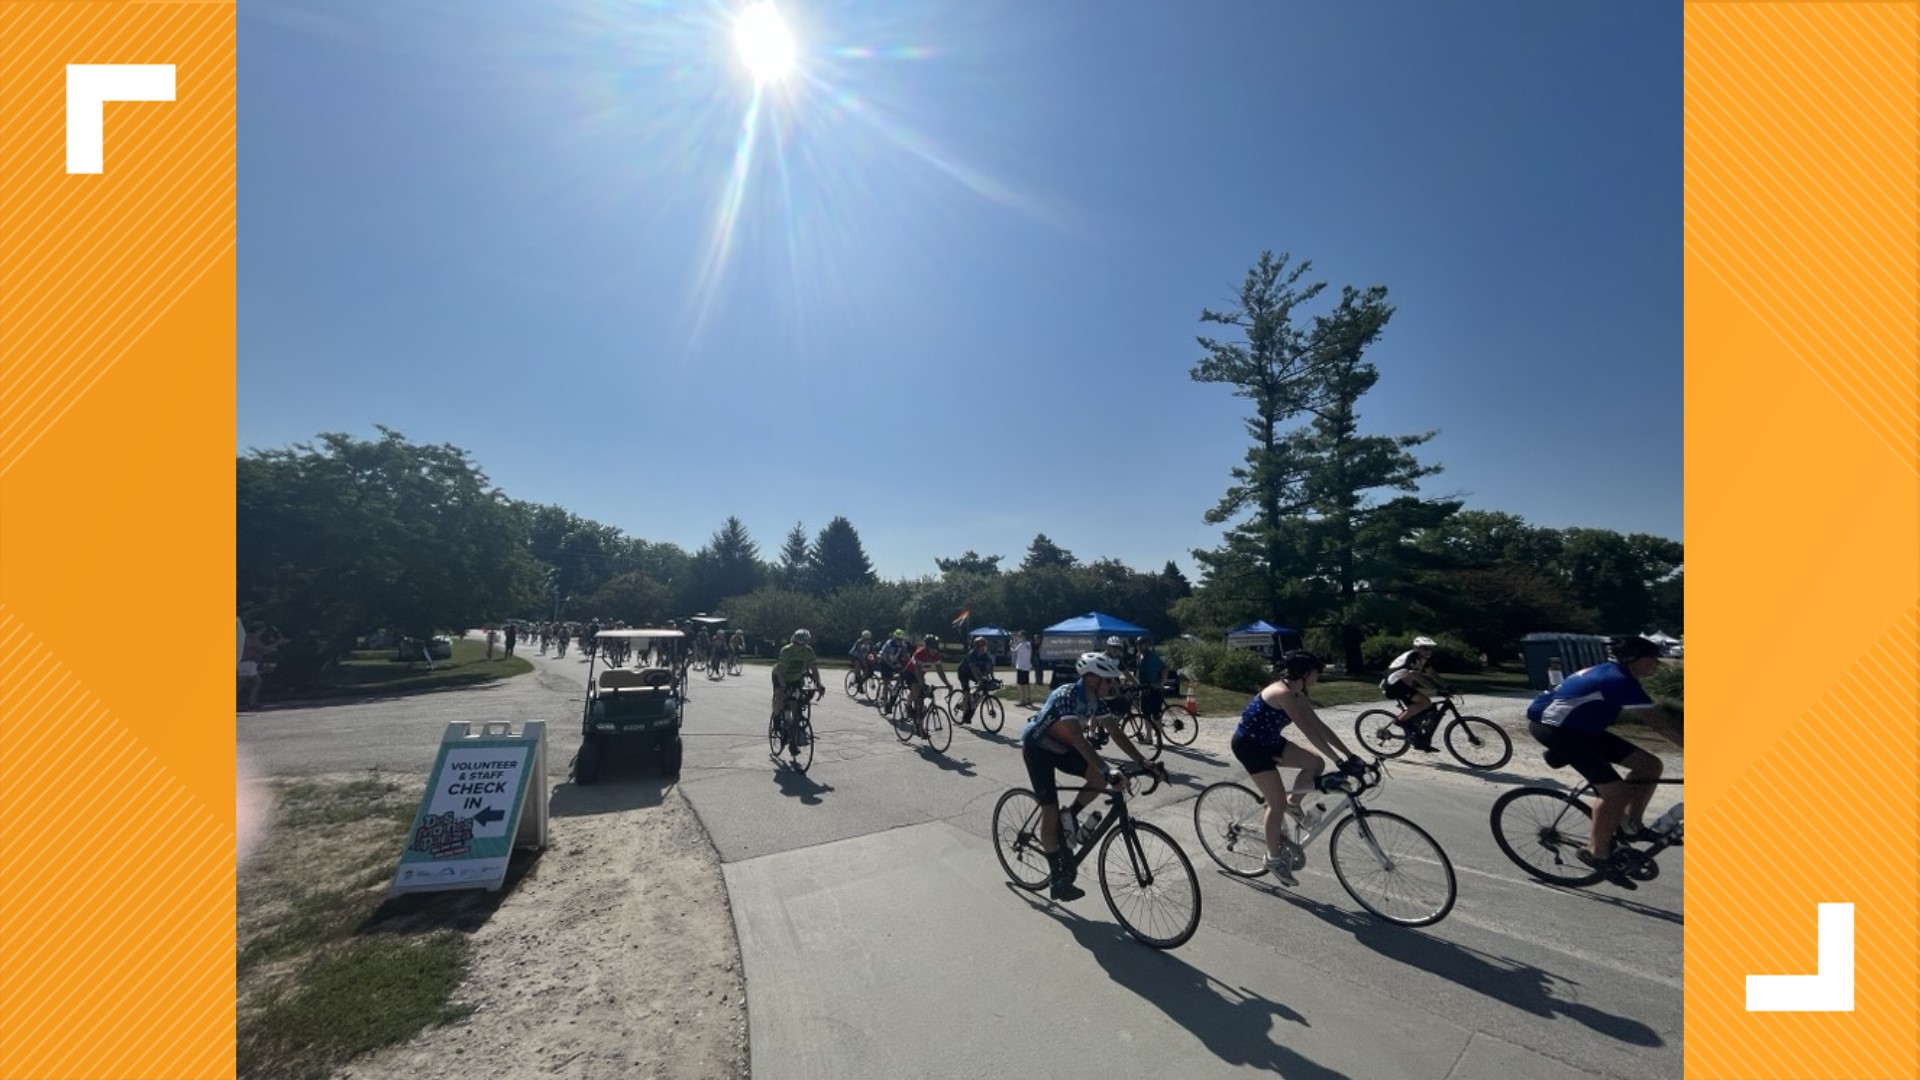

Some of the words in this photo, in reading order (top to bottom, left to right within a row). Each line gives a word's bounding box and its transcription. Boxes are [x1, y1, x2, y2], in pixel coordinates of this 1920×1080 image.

[451, 760, 518, 771] VOLUNTEER
[458, 772, 467, 781] &
[469, 770, 505, 780] STAFF
[448, 781, 508, 795] CHECK
[463, 797, 483, 809] IN
